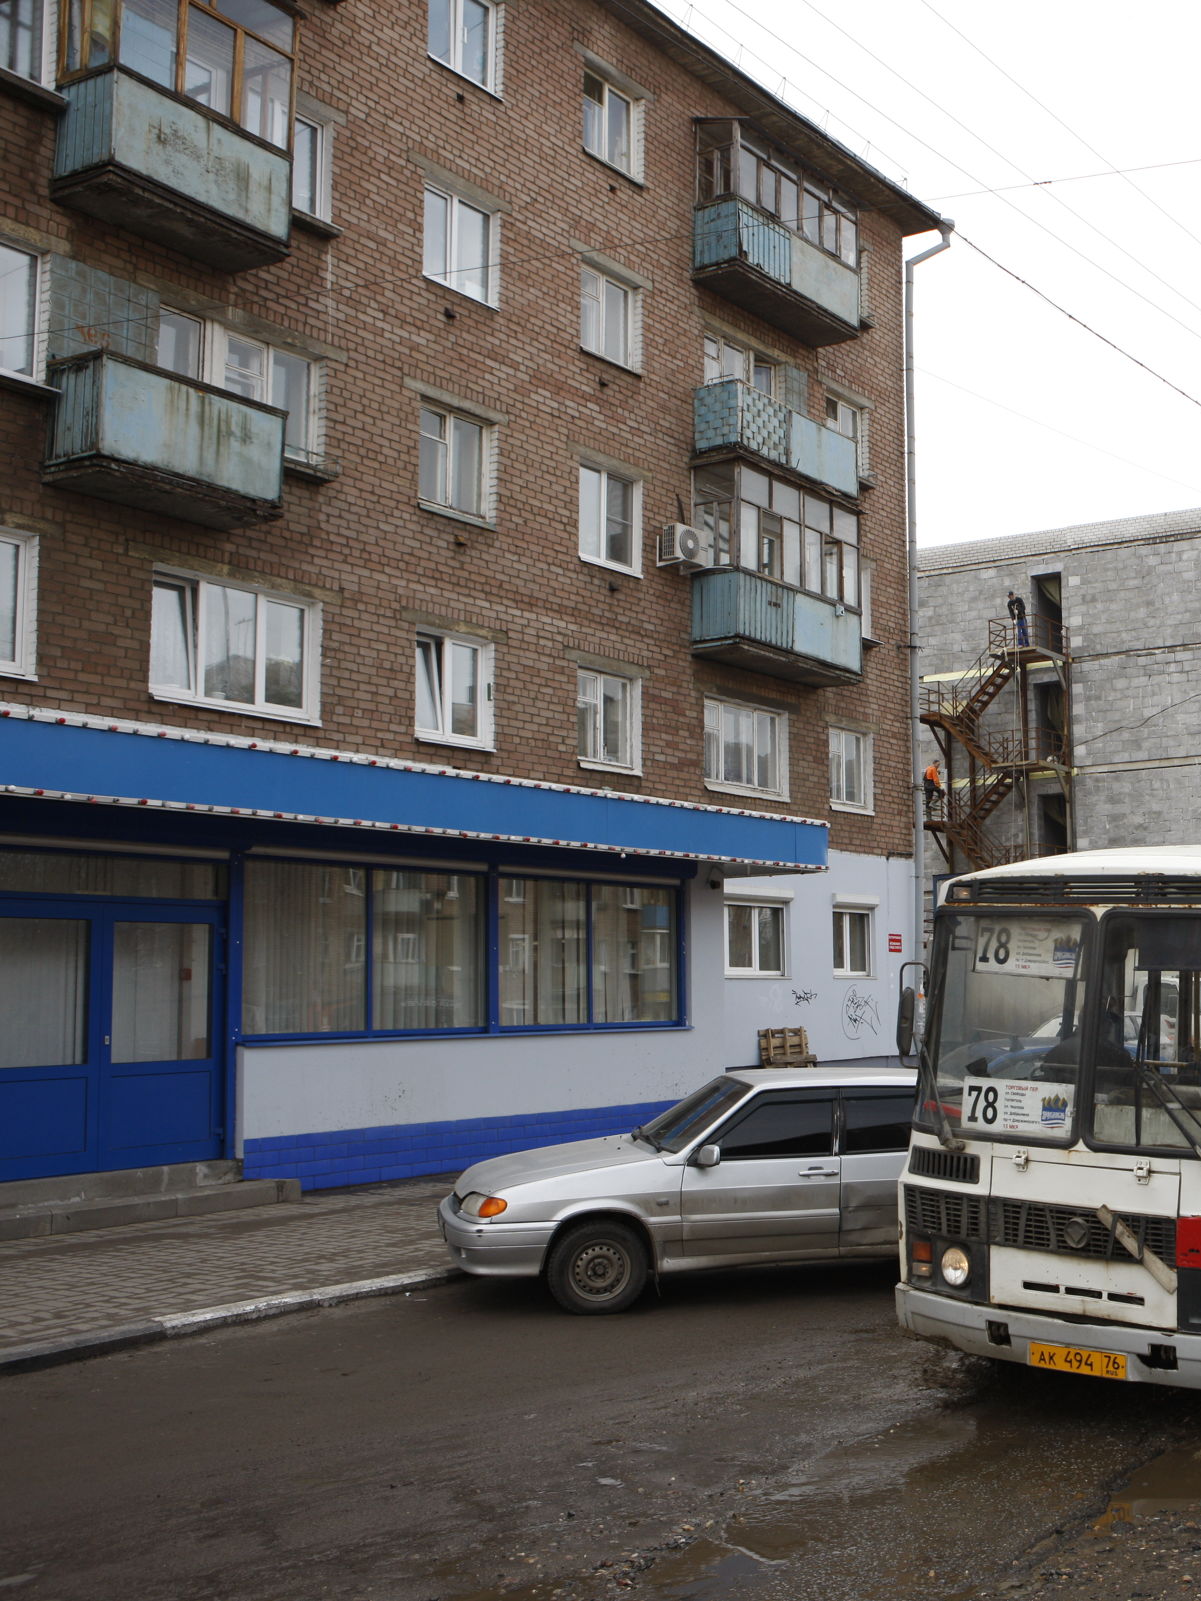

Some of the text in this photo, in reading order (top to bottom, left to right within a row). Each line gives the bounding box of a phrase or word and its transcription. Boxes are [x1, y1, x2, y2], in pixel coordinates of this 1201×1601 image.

[978, 927, 1011, 965] 78
[967, 1085, 999, 1125] 78
[1038, 1351, 1120, 1372] АК 494 76
[1105, 1369, 1119, 1377] RUS
